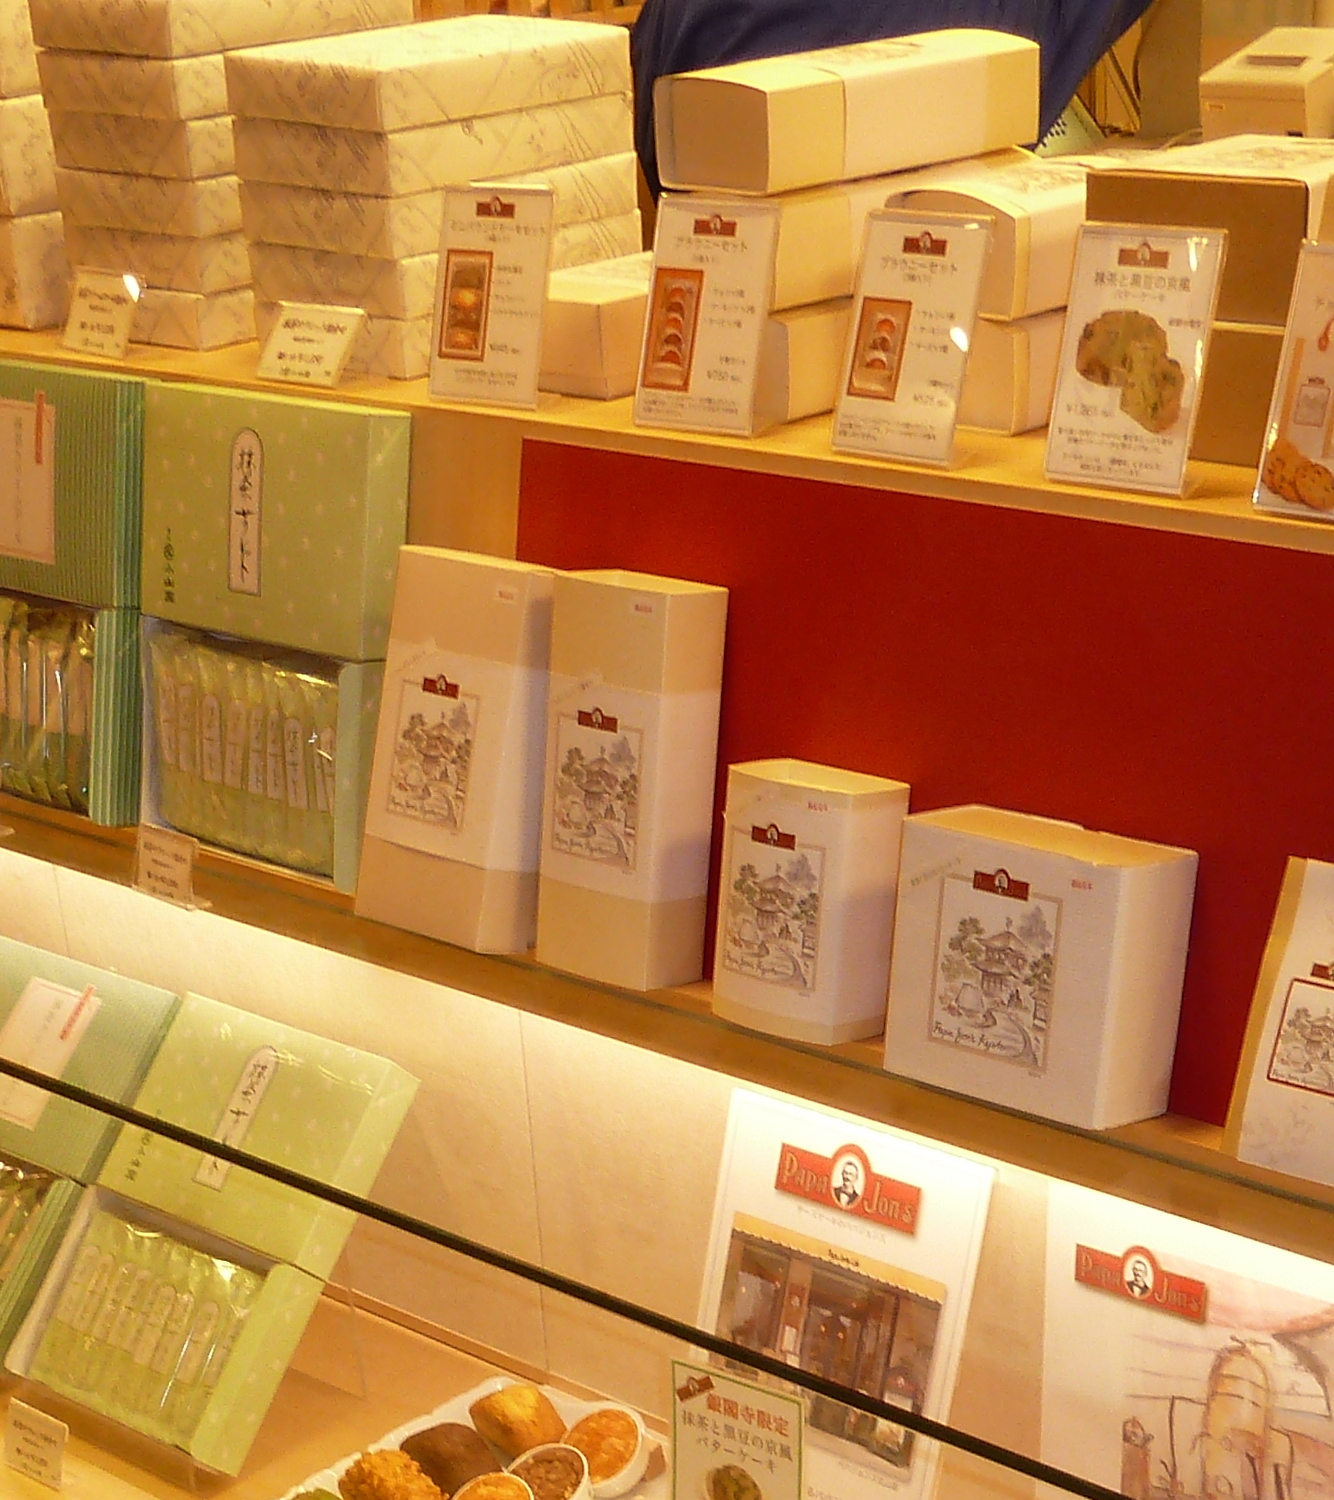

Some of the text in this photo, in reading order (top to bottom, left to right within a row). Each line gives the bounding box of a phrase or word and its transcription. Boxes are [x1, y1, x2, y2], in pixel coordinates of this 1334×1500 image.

[681, 1410, 793, 1462] 抹茶と黒豆の京風
[706, 1393, 790, 1438] 銀閣寺限定
[697, 1437, 777, 1475] バターケーキ
